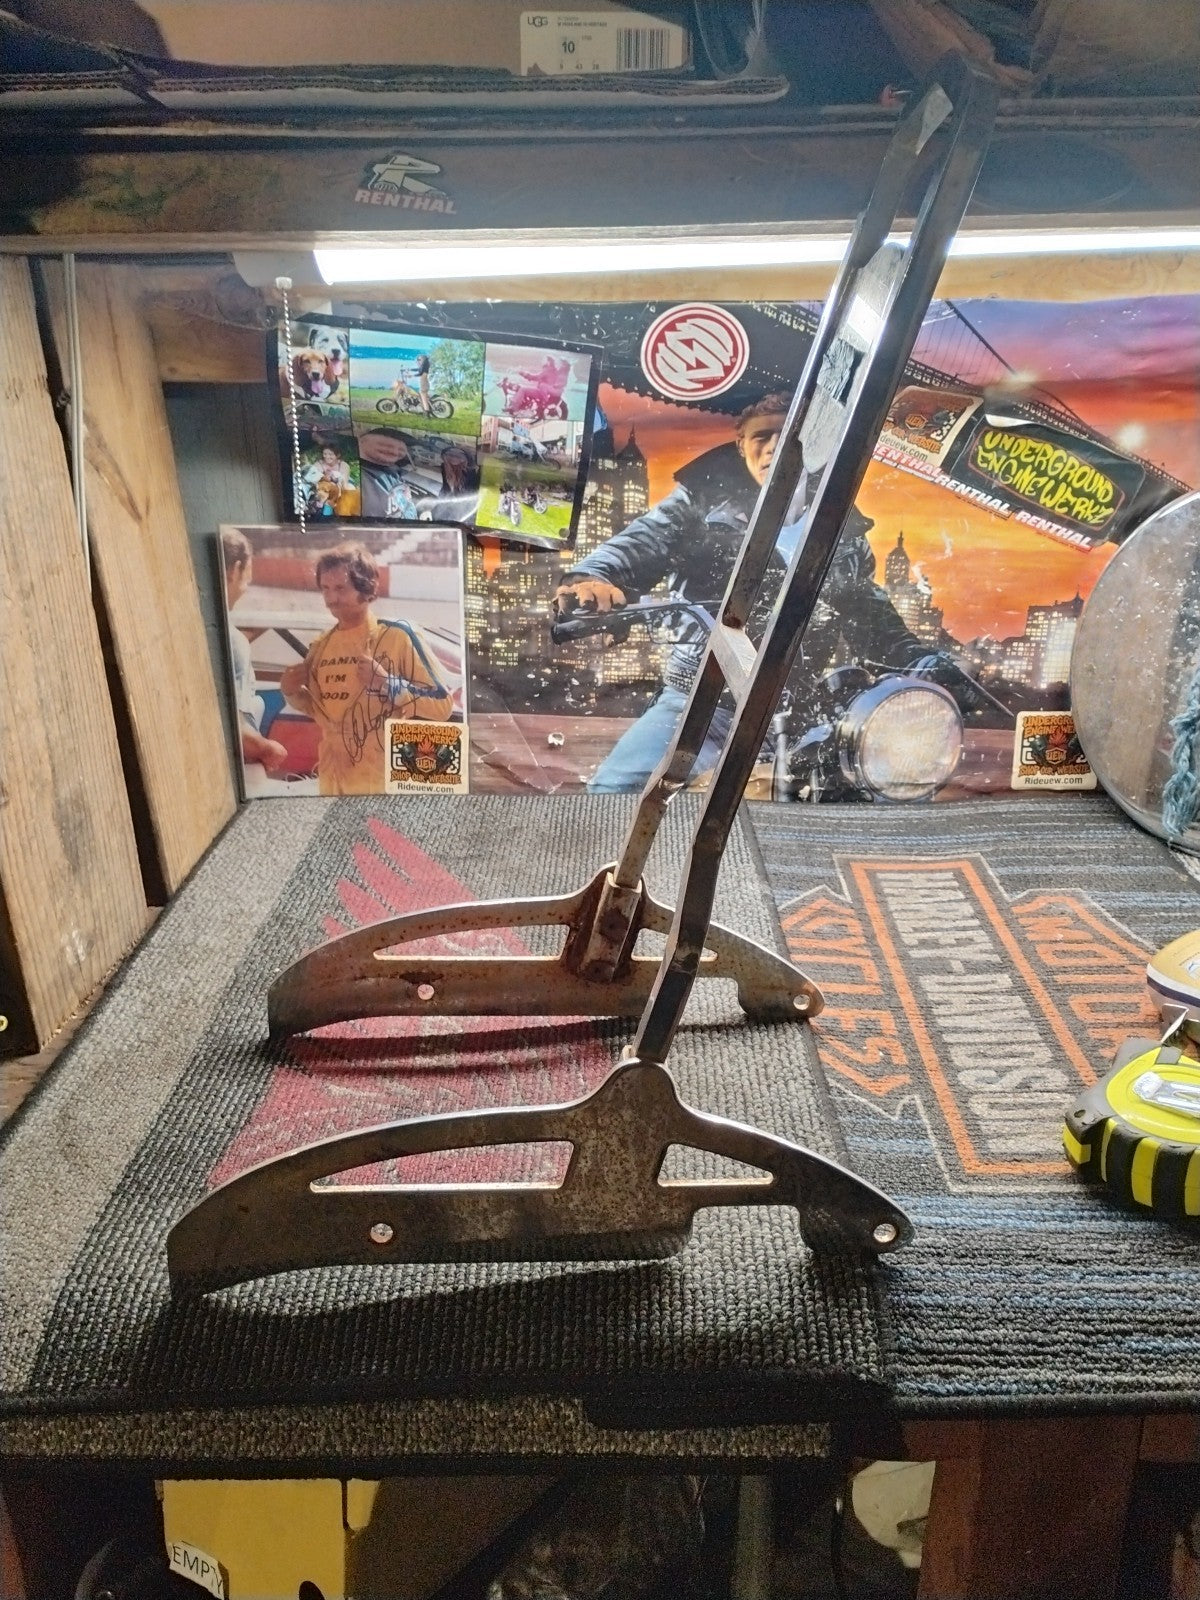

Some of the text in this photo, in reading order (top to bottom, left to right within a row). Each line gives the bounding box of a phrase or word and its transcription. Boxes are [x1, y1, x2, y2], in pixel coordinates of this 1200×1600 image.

[527, 16, 548, 28] UGG
[562, 40, 575, 54] 10
[354, 189, 457, 215] RENTHAL
[879, 434, 929, 462] deuew.com
[983, 430, 1115, 503] UNDERGROUND
[976, 445, 1044, 497] ENGINE
[1040, 480, 1114, 524] WERKZ
[934, 474, 1012, 516] RENTHAL
[1015, 510, 1093, 548] RENTHAL
[320, 656, 359, 668] DAMN
[325, 674, 347, 684] I'M
[1022, 715, 1075, 728] UNDERGR
[390, 723, 462, 737] UNDERGROUND
[392, 733, 458, 745] ENGINE WERKZ
[1024, 777, 1083, 785] Rideuew.com
[397, 783, 454, 794] Rideuew.com
[875, 871, 1077, 1156] HARLEY-DAVIDSON
